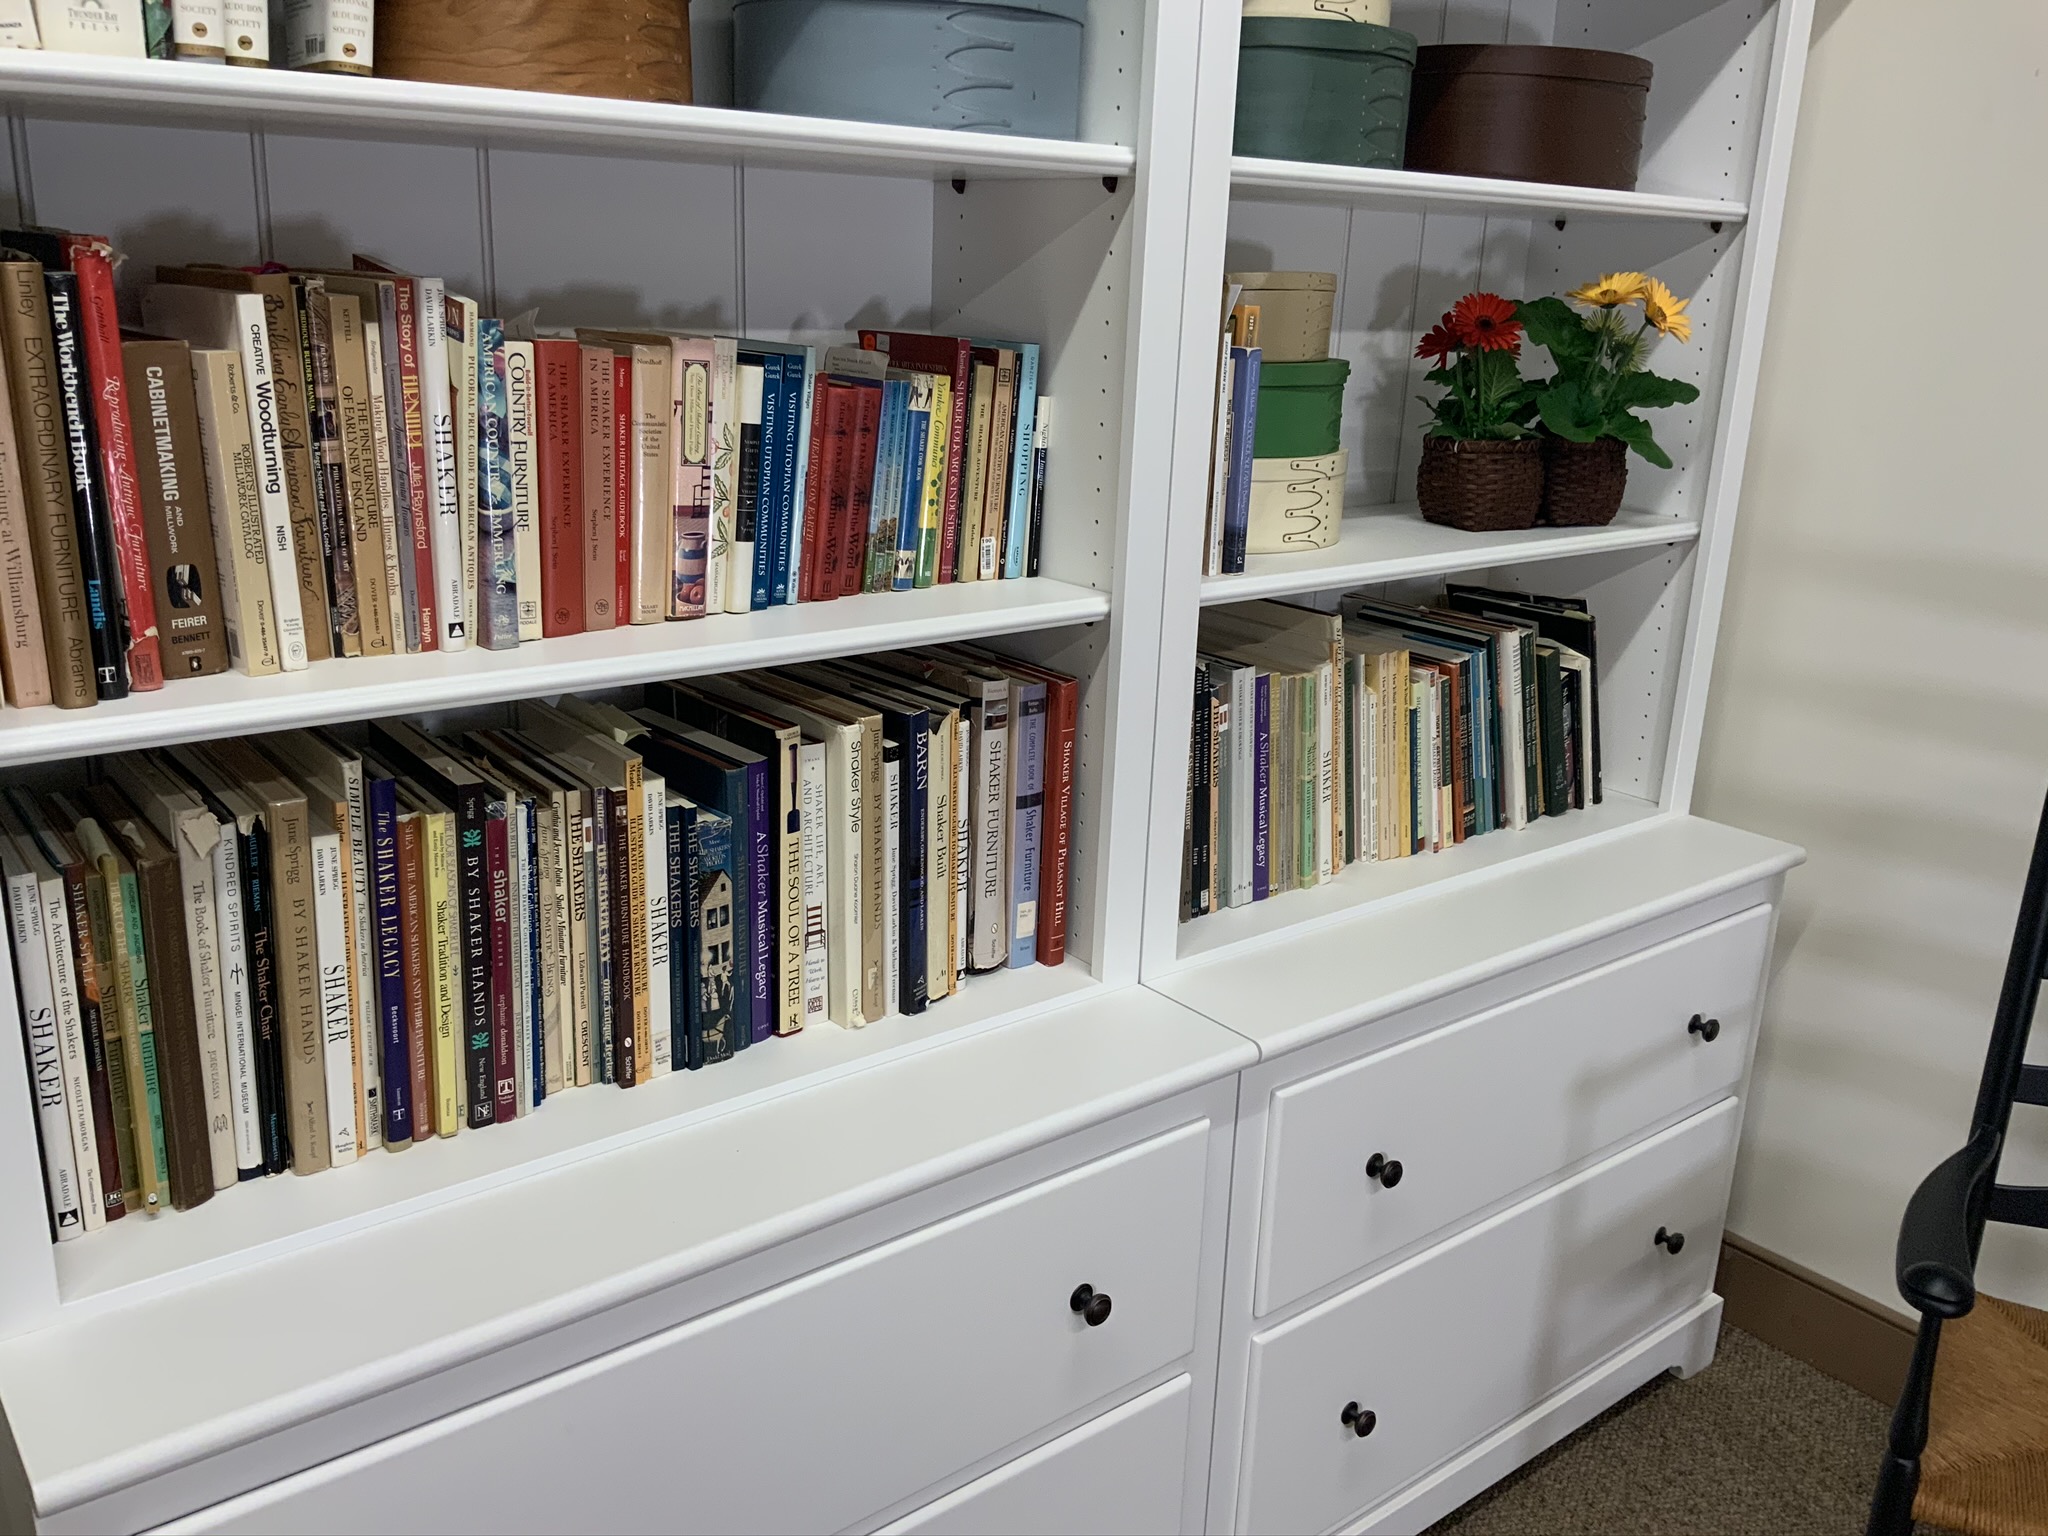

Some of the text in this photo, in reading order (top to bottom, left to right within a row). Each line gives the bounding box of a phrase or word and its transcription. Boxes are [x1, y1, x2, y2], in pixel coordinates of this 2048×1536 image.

[180, 5, 217, 16] SOCIETY
[424, 288, 435, 347] DAVID LARKIN
[51, 292, 92, 492] The Workbench Book
[590, 358, 598, 435] IN AMERICA
[931, 382, 946, 469] Yankee Communes
[954, 380, 965, 423] SHAKER
[145, 366, 180, 501] CABINETMAKING
[250, 324, 287, 551] CREATIVE Woodturning NISH
[342, 386, 367, 542] OF EARLY NEW ENGLAND
[356, 399, 379, 528] THE PINE FURNITURE
[433, 413, 457, 517] SHAKER
[507, 352, 531, 532] COUNTRY FURNITURE
[601, 358, 612, 521] THE SHAKER EXPERIENCE
[918, 431, 926, 451] SHAKER
[951, 454, 960, 475] ART
[952, 425, 962, 453] FOLK
[1019, 423, 1032, 497] SHOPPING
[1038, 423, 1048, 491] Nights to Imagine
[17, 269, 89, 698] Linley EXTRAORDINARY FURNITURE Abrams
[232, 452, 254, 560] MILLWORK CATALOG
[758, 393, 776, 576] VISITING UTOPIAN COMMUNITIES
[778, 392, 797, 572] VISITING UTOPIAN COMMUNITIES
[950, 475, 958, 485] &
[973, 457, 982, 502] ADVENTURE
[945, 486, 958, 549] INDUSTRIES
[87, 579, 106, 630] Landis
[171, 616, 208, 629] FEIRER
[421, 608, 432, 643] Hamlyn
[450, 579, 461, 620] ABRADALE
[171, 631, 210, 645] BENNETT
[916, 732, 927, 791] BARN
[1212, 730, 1220, 788] SHAKERS
[1258, 741, 1269, 785] Shaker
[1260, 732, 1268, 740] A
[849, 741, 861, 833] Shaker Style
[890, 774, 898, 830] SHAKER
[1258, 786, 1268, 829] Musical
[1322, 751, 1331, 803] SHAKER
[669, 821, 680, 853] THE
[687, 821, 698, 854] THE
[757, 832, 766, 843] A
[803, 780, 813, 897] AND ARCHITECTURE
[936, 794, 948, 880] Shaker Built
[985, 741, 1001, 898] SHAKER FURNITURE
[1256, 830, 1268, 867] Legacy
[316, 848, 327, 896] DAVID LARKIN
[670, 856, 683, 928] SHAKERS
[688, 856, 700, 928] SHAKERS
[756, 844, 769, 896] Shaker
[957, 819, 968, 893] SHAKER
[12, 886, 27, 944] DAVID LARKIN
[222, 838, 241, 953] KINDRED SPIRITS
[376, 811, 401, 979] The SHAKER LEGACY
[466, 797, 486, 1026] Sprigg BY SHAKER HANDS
[618, 833, 632, 1001] THE SHAKER FURNITURE HANDBOOK
[757, 900, 768, 952] Musical
[788, 838, 800, 1007] THE SOUL OF A TREE
[71, 883, 94, 987] SHAKER STYLE
[192, 881, 218, 1040] The Book of Shaker Furniture
[282, 817, 316, 1065] June Sprigg BY SHAKER HANDS
[650, 897, 669, 968] SHAKER
[48, 899, 78, 1060] The Architecture of the Shakers
[253, 927, 274, 1041] The Shaker Chair
[323, 964, 349, 1044] SHAKER
[436, 900, 452, 1038] Shaker Tradition and Design
[756, 954, 769, 1000] Legacy
[29, 1007, 63, 1110] SHAKER
[135, 979, 160, 1096] Shaker Furniture
[234, 991, 250, 1114] MINGEI INTERNATIONAL MUSEUM
[390, 1006, 400, 1044] Becksvoort
[581, 1020, 589, 1068] CRESCENT
[269, 1113, 279, 1161] Massachusetts
[58, 1168, 72, 1208] ABRADALE
